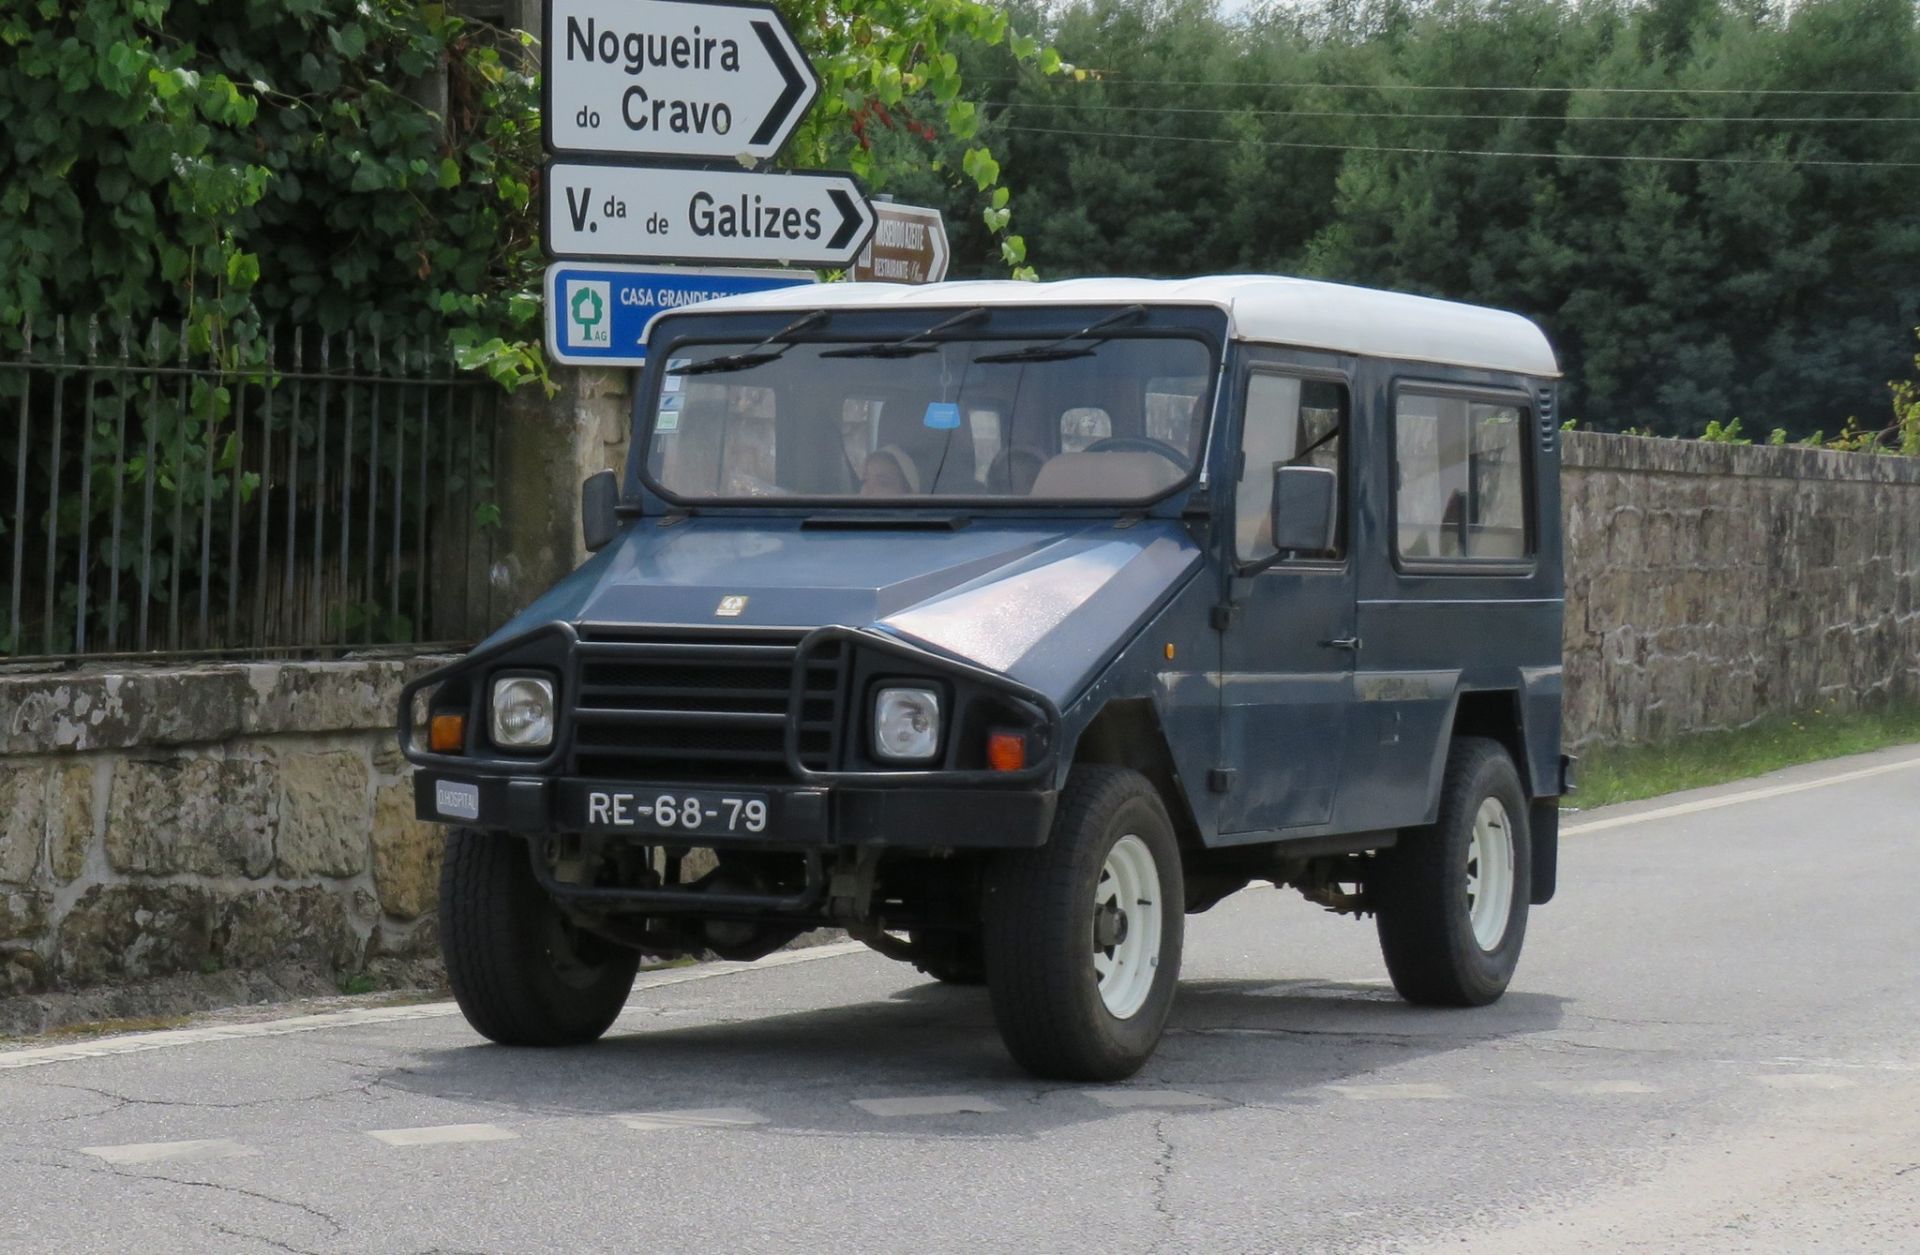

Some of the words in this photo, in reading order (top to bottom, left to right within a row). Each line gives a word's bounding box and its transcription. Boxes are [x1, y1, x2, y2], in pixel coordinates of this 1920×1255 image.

[567, 15, 740, 75] Nogueira
[576, 105, 601, 129] do
[621, 84, 732, 136] Cravo
[646, 211, 669, 235] de
[688, 191, 822, 241] Galizes
[620, 287, 655, 306] CASA
[595, 331, 607, 341] AG
[589, 792, 767, 832] RE-68-79
